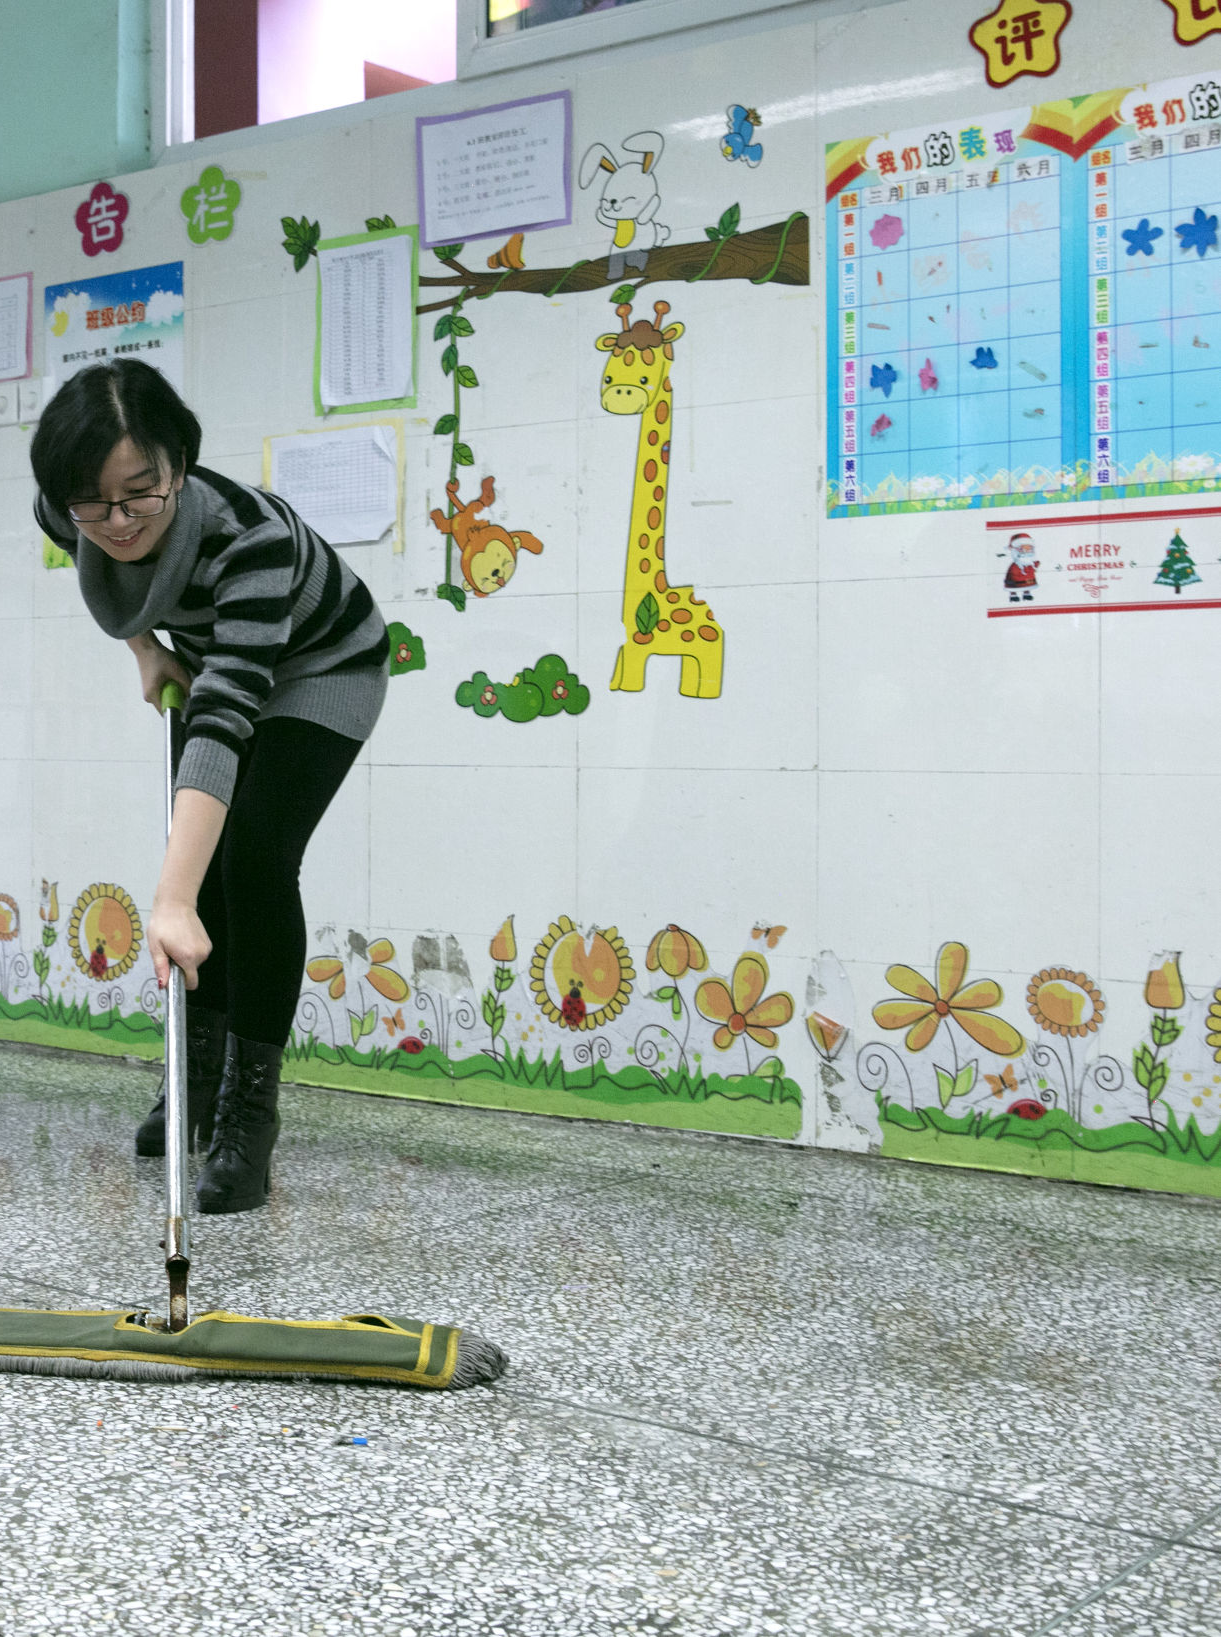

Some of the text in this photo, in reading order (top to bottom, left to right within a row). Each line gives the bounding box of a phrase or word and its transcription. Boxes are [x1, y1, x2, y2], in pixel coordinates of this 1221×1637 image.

[876, 126, 1017, 176] 我们的表现
[915, 177, 948, 196] 四月
[86, 301, 146, 331] 班级公约
[1069, 544, 1122, 559] MERRY
[1067, 561, 1124, 572] CHRISTMAS
